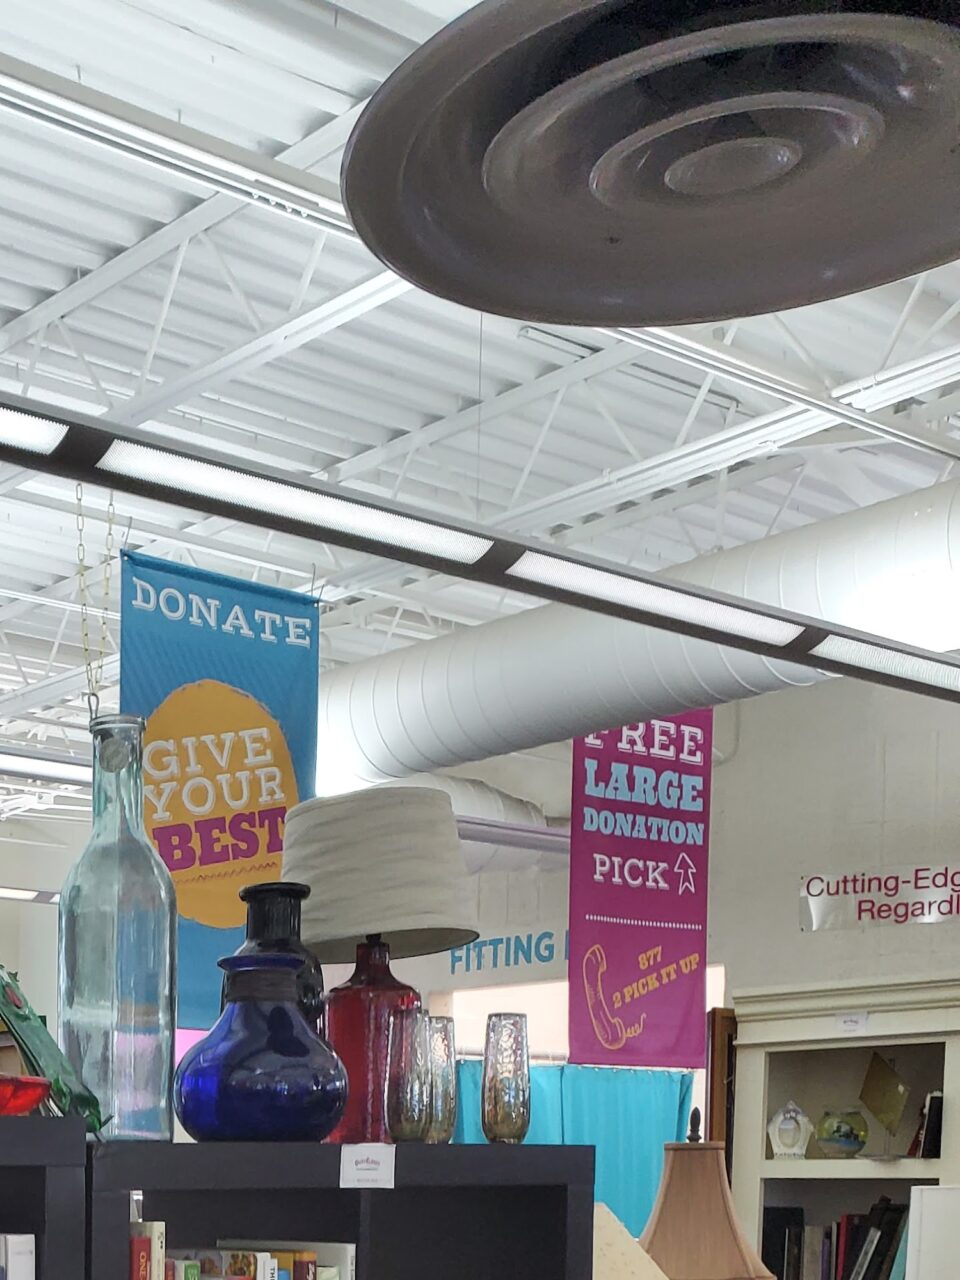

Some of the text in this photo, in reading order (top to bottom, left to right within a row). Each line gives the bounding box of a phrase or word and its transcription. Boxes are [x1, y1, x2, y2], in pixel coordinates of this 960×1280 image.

[131, 577, 312, 649] DONATE
[142, 727, 272, 780] GIVE
[144, 767, 285, 821] YOUR
[584, 757, 704, 812] LARGE
[152, 806, 289, 872] BEST
[583, 807, 705, 846] DONATION
[592, 853, 670, 890] PICK
[450, 930, 555, 975] FITTING
[638, 945, 662, 970] 877
[612, 952, 700, 1009] 2 PICK IT UP
